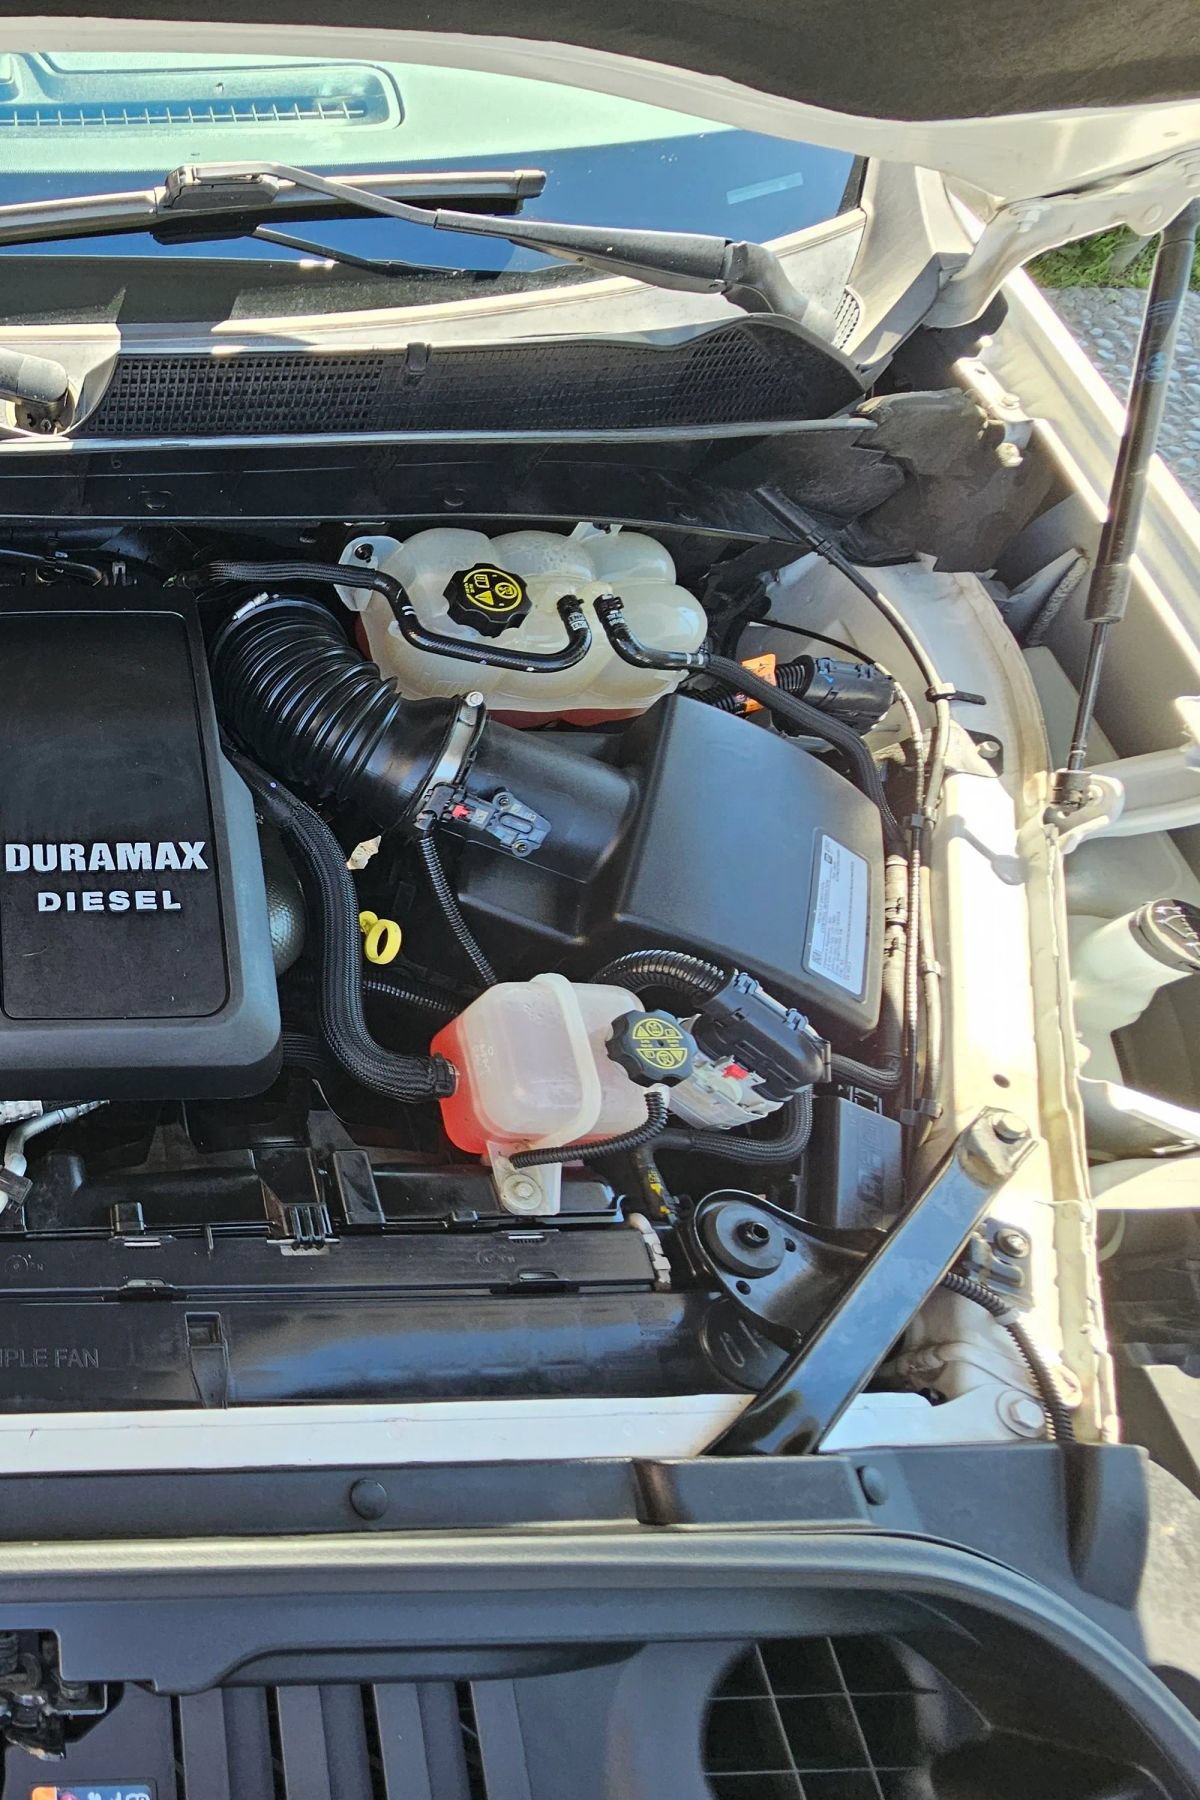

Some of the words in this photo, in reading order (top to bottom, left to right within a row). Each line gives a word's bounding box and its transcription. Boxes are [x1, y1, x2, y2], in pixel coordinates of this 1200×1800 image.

[5, 841, 209, 872] DURAMAX
[37, 890, 182, 912] DIESEL
[54, 1348, 99, 1369] FAN
